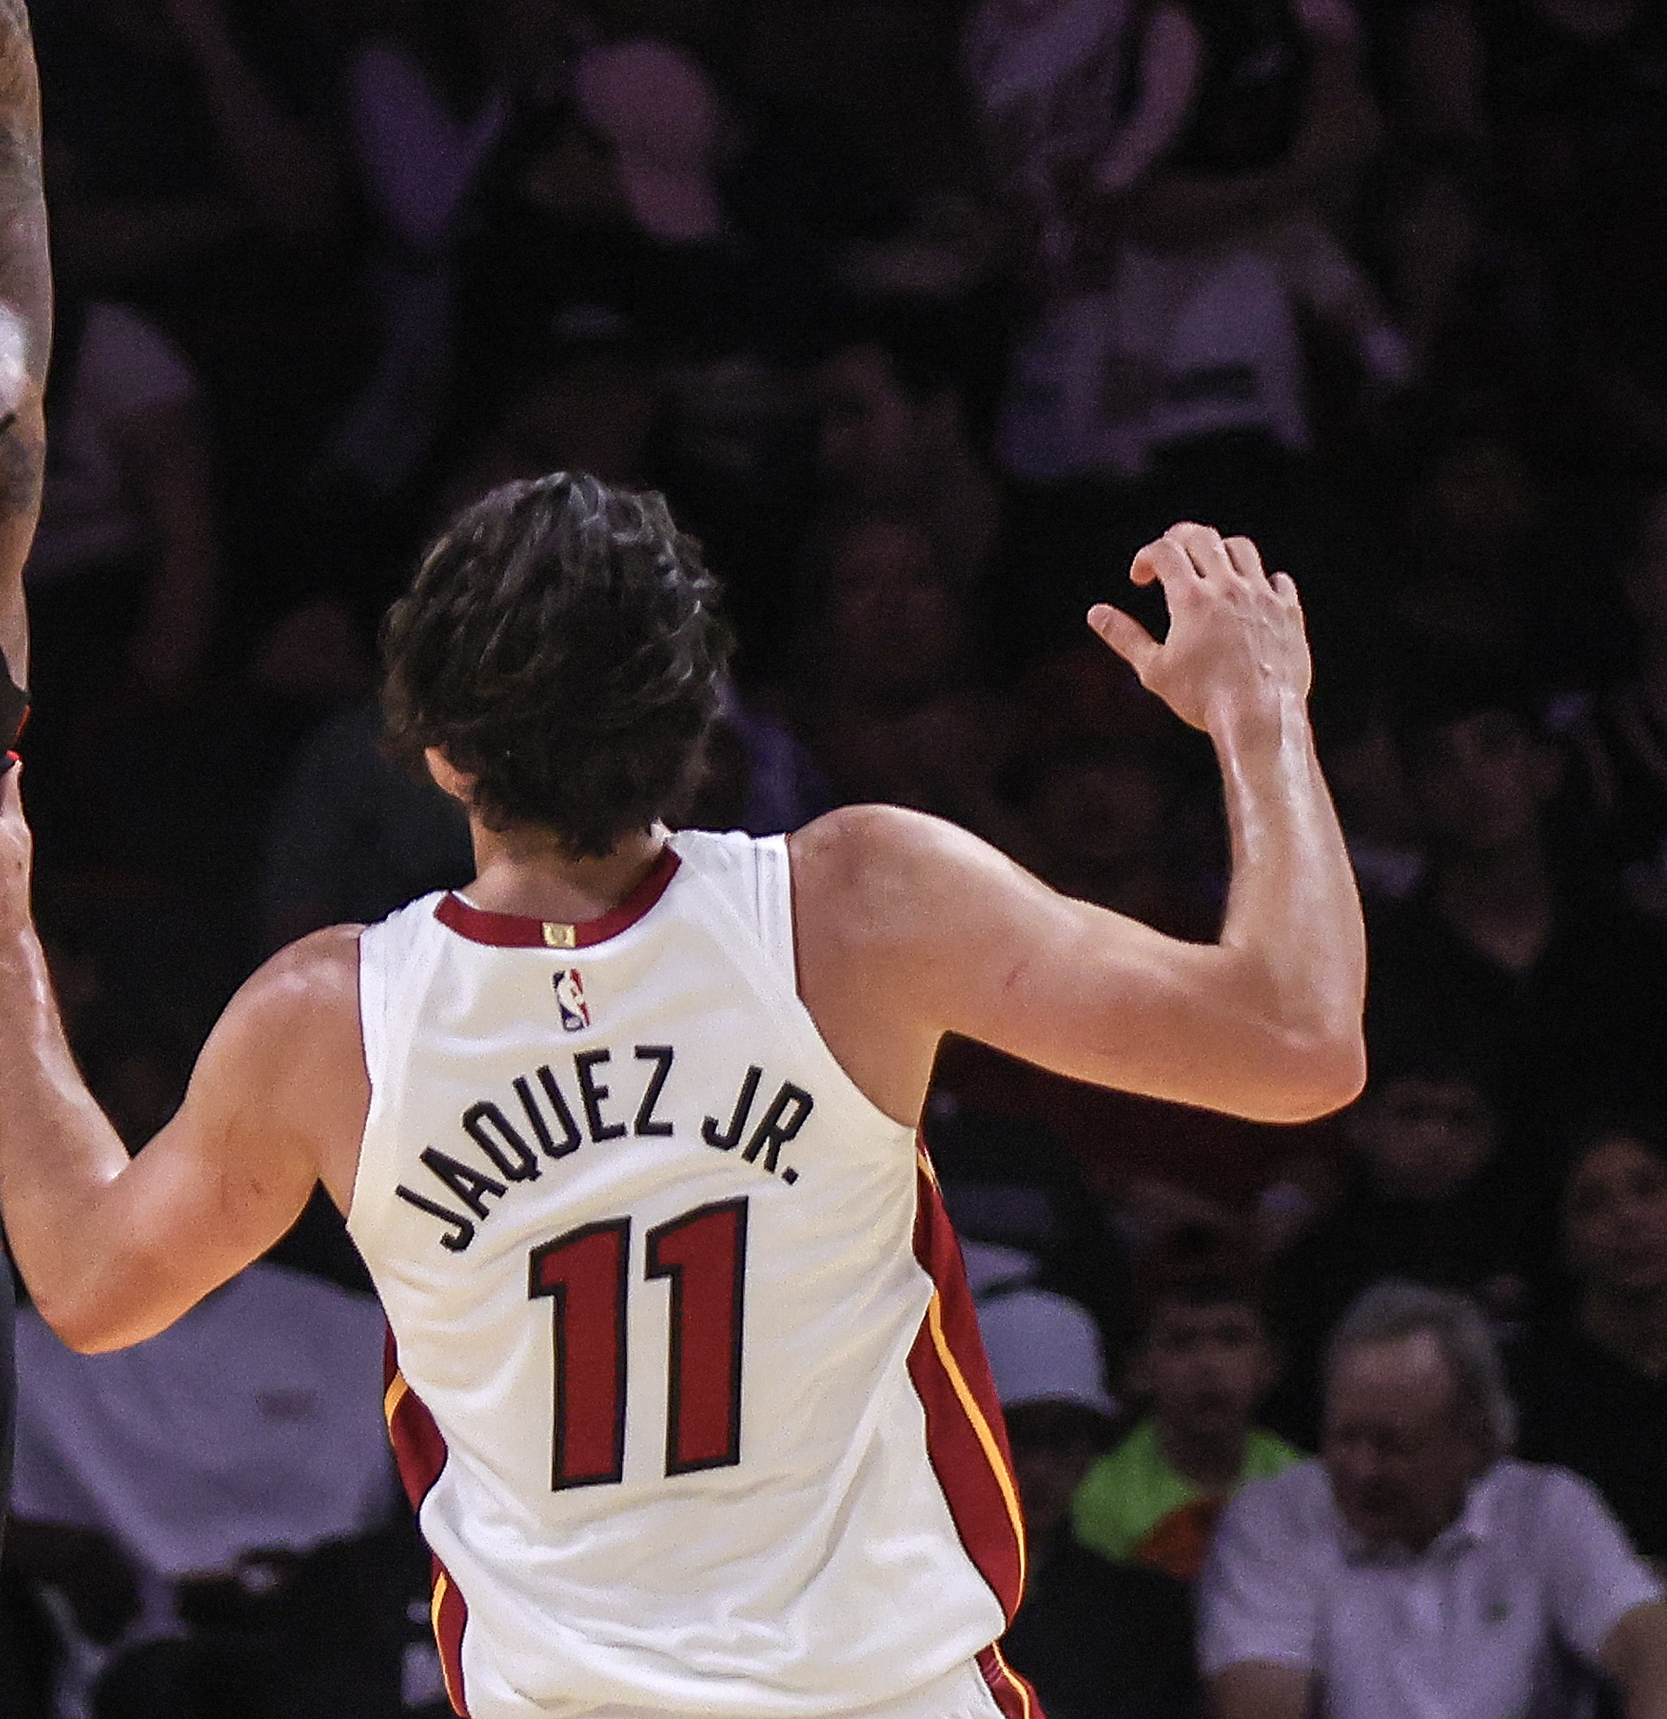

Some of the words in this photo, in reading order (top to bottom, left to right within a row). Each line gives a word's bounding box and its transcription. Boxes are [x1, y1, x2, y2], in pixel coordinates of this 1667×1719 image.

[395, 1045, 674, 1254] JAQUEZ
[700, 1064, 815, 1186] JR.
[527, 1194, 750, 1492] 11
